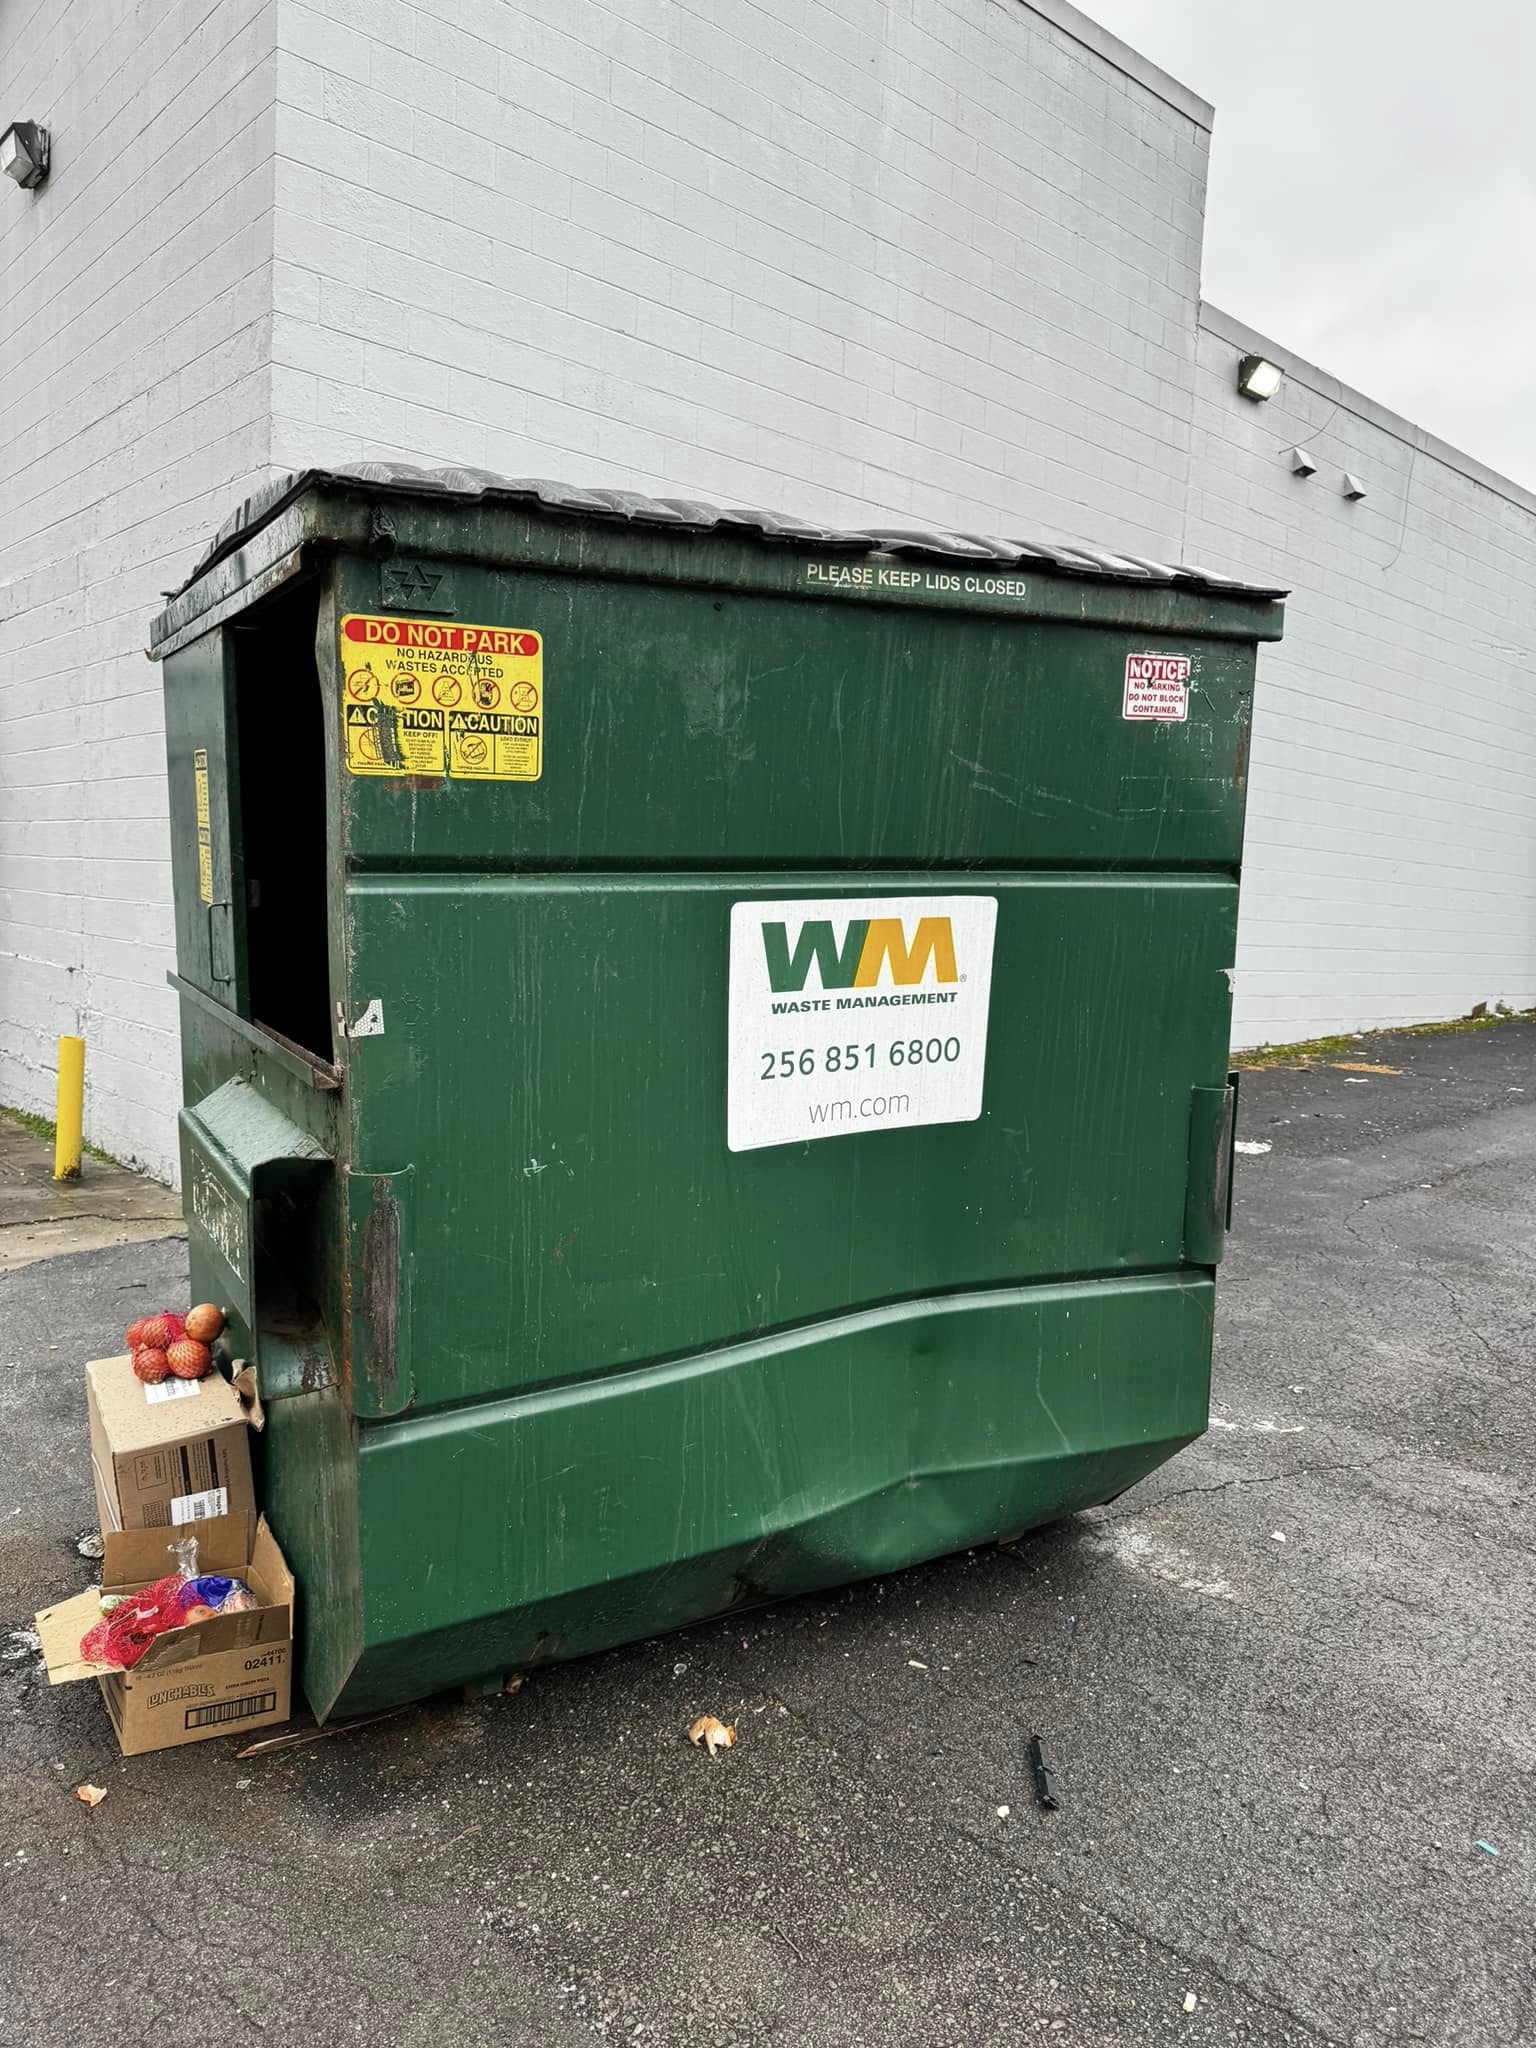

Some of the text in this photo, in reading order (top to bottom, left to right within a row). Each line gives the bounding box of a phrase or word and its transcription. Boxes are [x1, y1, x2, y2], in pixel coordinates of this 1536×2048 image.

[807, 563, 1026, 597] PLEASE KEEP LIDS CLOSED
[365, 620, 525, 655] DO NOT PARK
[385, 659, 437, 673] WASTES
[397, 648, 493, 665] NO HAZARDUS
[1129, 659, 1187, 680] NOTICE
[1129, 693, 1184, 703] DO NOT BLOCK
[1134, 682, 1181, 691] NO ARKING
[366, 706, 443, 729] CTION
[467, 713, 538, 734] CAUTION
[761, 917, 958, 993] WM
[771, 992, 958, 1015] WASTE MANAGEMENT
[760, 1037, 961, 1081] 256 851 6800
[809, 1094, 910, 1124] wm.com
[146, 1682, 217, 1709] LUNCHABLES
